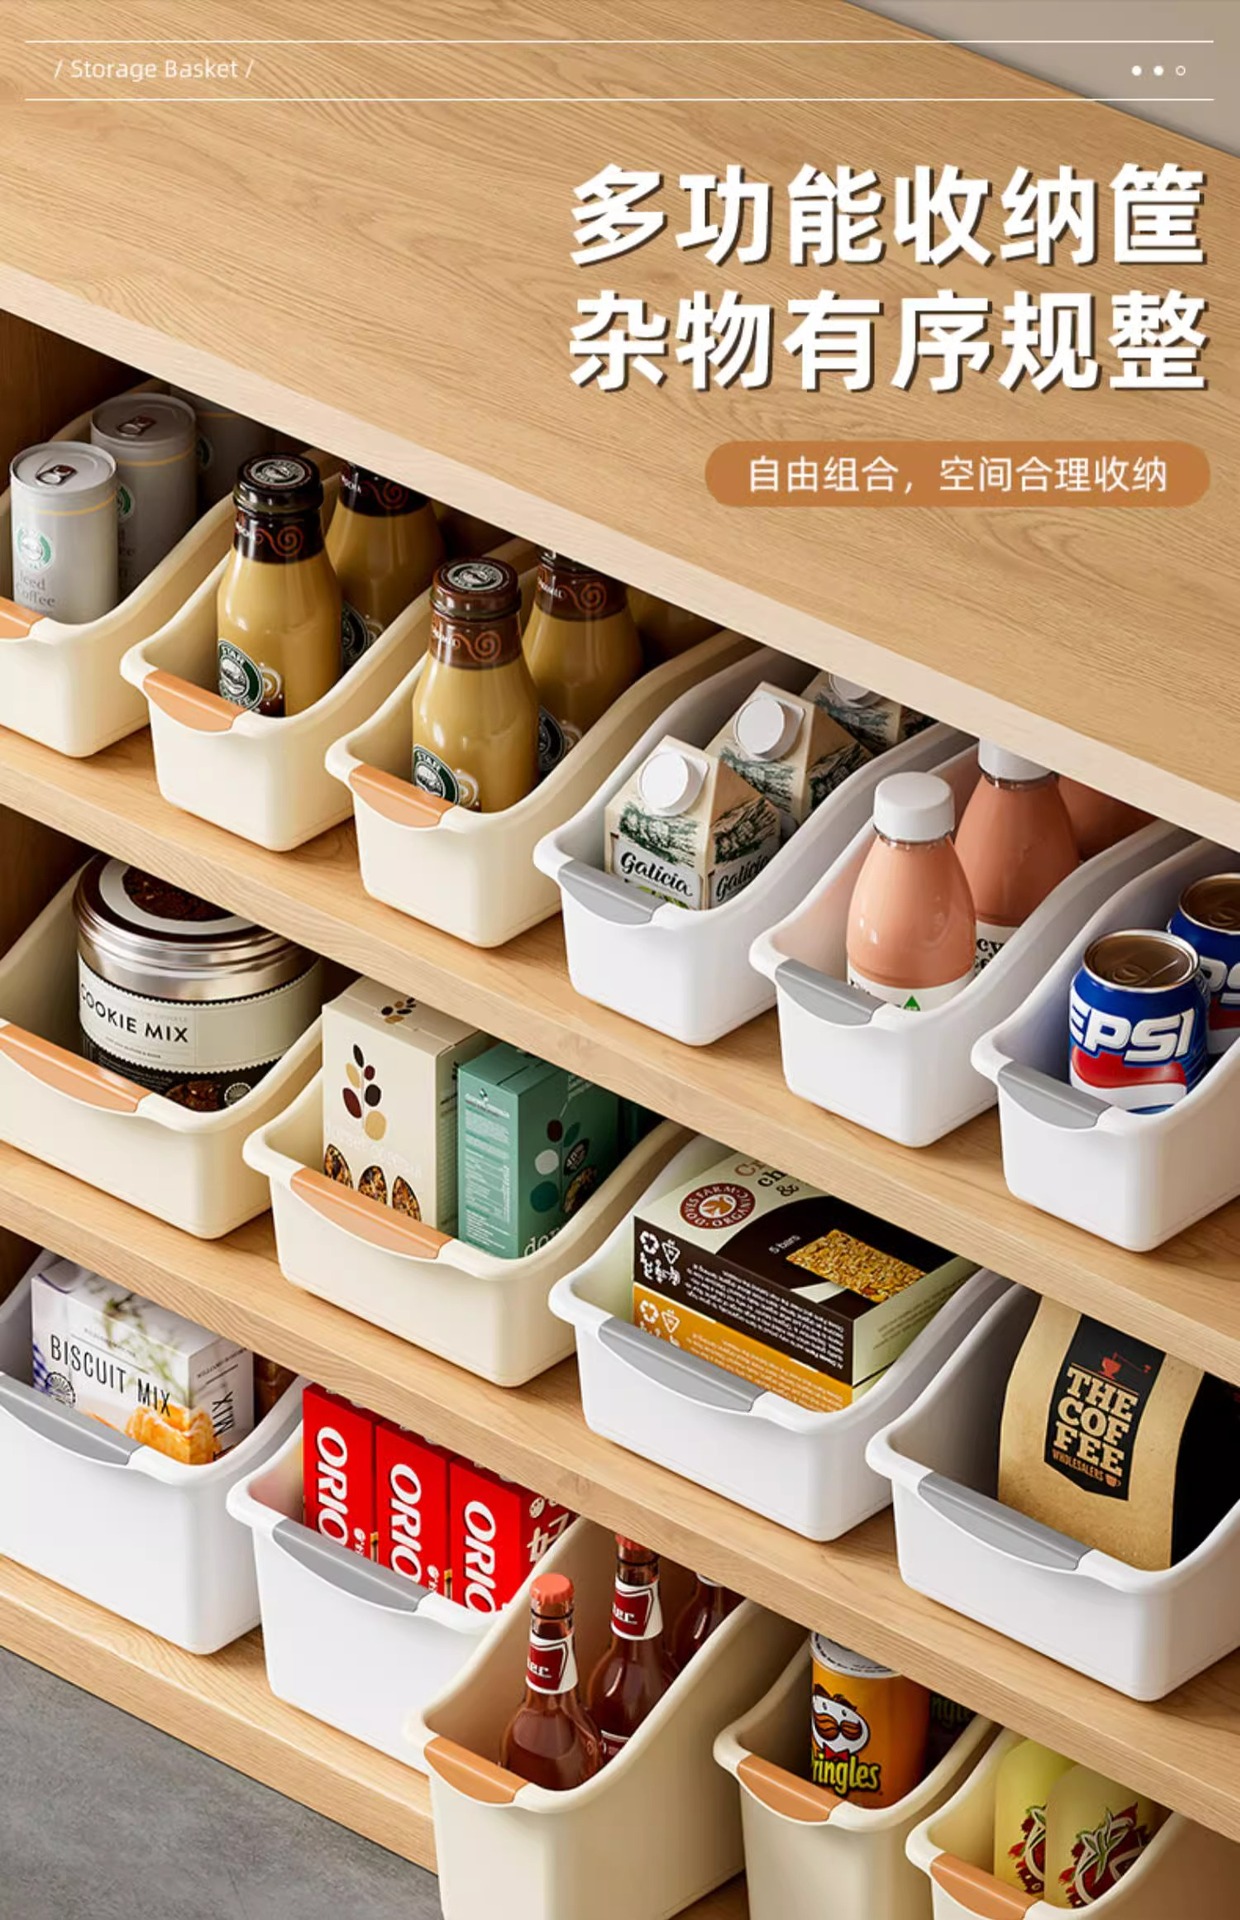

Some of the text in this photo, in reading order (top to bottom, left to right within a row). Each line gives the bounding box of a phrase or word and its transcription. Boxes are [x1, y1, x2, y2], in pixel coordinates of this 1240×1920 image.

[620, 851, 694, 897] Galicia
[145, 1021, 189, 1044] MIX
[50, 1334, 127, 1394] BISCUIT
[136, 1377, 172, 1418] MIX
[1066, 1366, 1139, 1422] THE
[1057, 1396, 1131, 1446] COF
[1052, 1420, 1126, 1478] FEE
[811, 1750, 880, 1796] ringles
